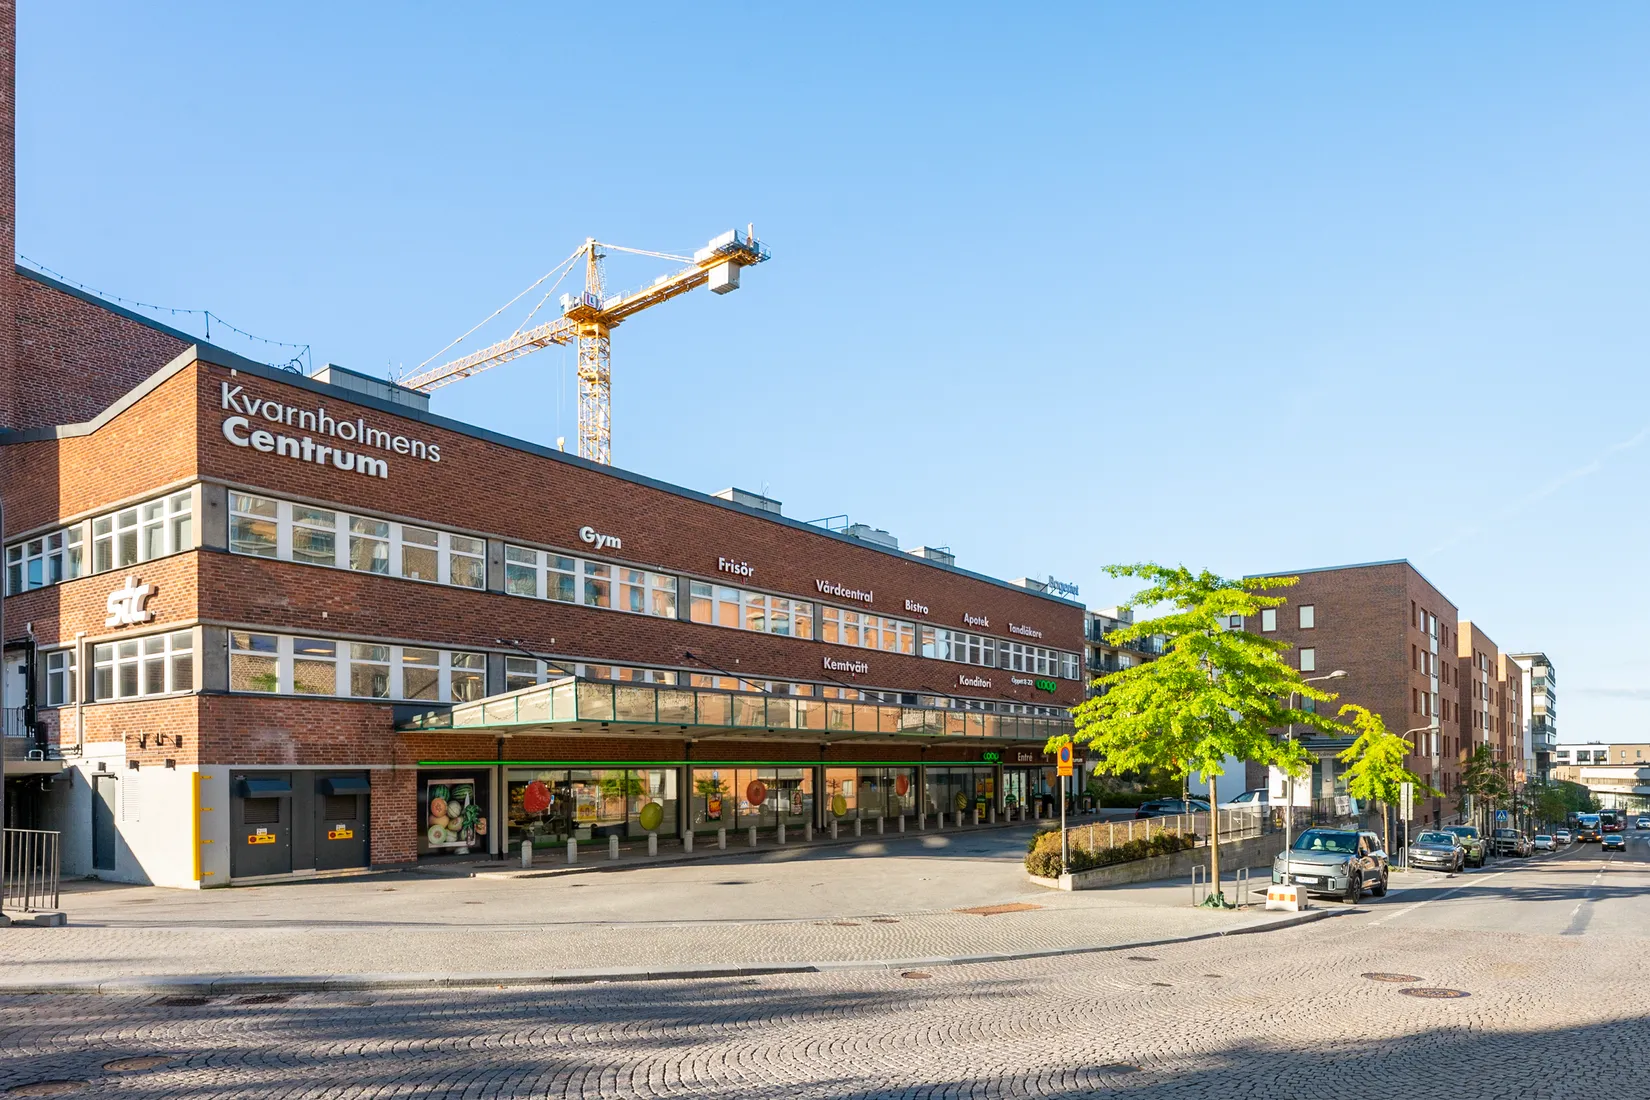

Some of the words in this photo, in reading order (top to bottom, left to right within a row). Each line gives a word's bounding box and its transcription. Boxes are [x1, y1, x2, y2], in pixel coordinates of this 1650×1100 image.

[221, 381, 441, 463] Kvarnholmens
[222, 416, 388, 479] Centrum
[579, 526, 622, 549] Gym
[718, 557, 754, 577] Frisör
[816, 579, 873, 603] Vårdcentral
[905, 600, 929, 615] Bistro
[963, 613, 989, 627] Apotek
[1008, 622, 1042, 639] Tandläkare
[823, 657, 868, 674] Kemtvätt
[959, 675, 992, 688] Konditori
[1035, 680, 1057, 694] coop
[983, 752, 1000, 760] coop
[1017, 752, 1033, 762] Entré
